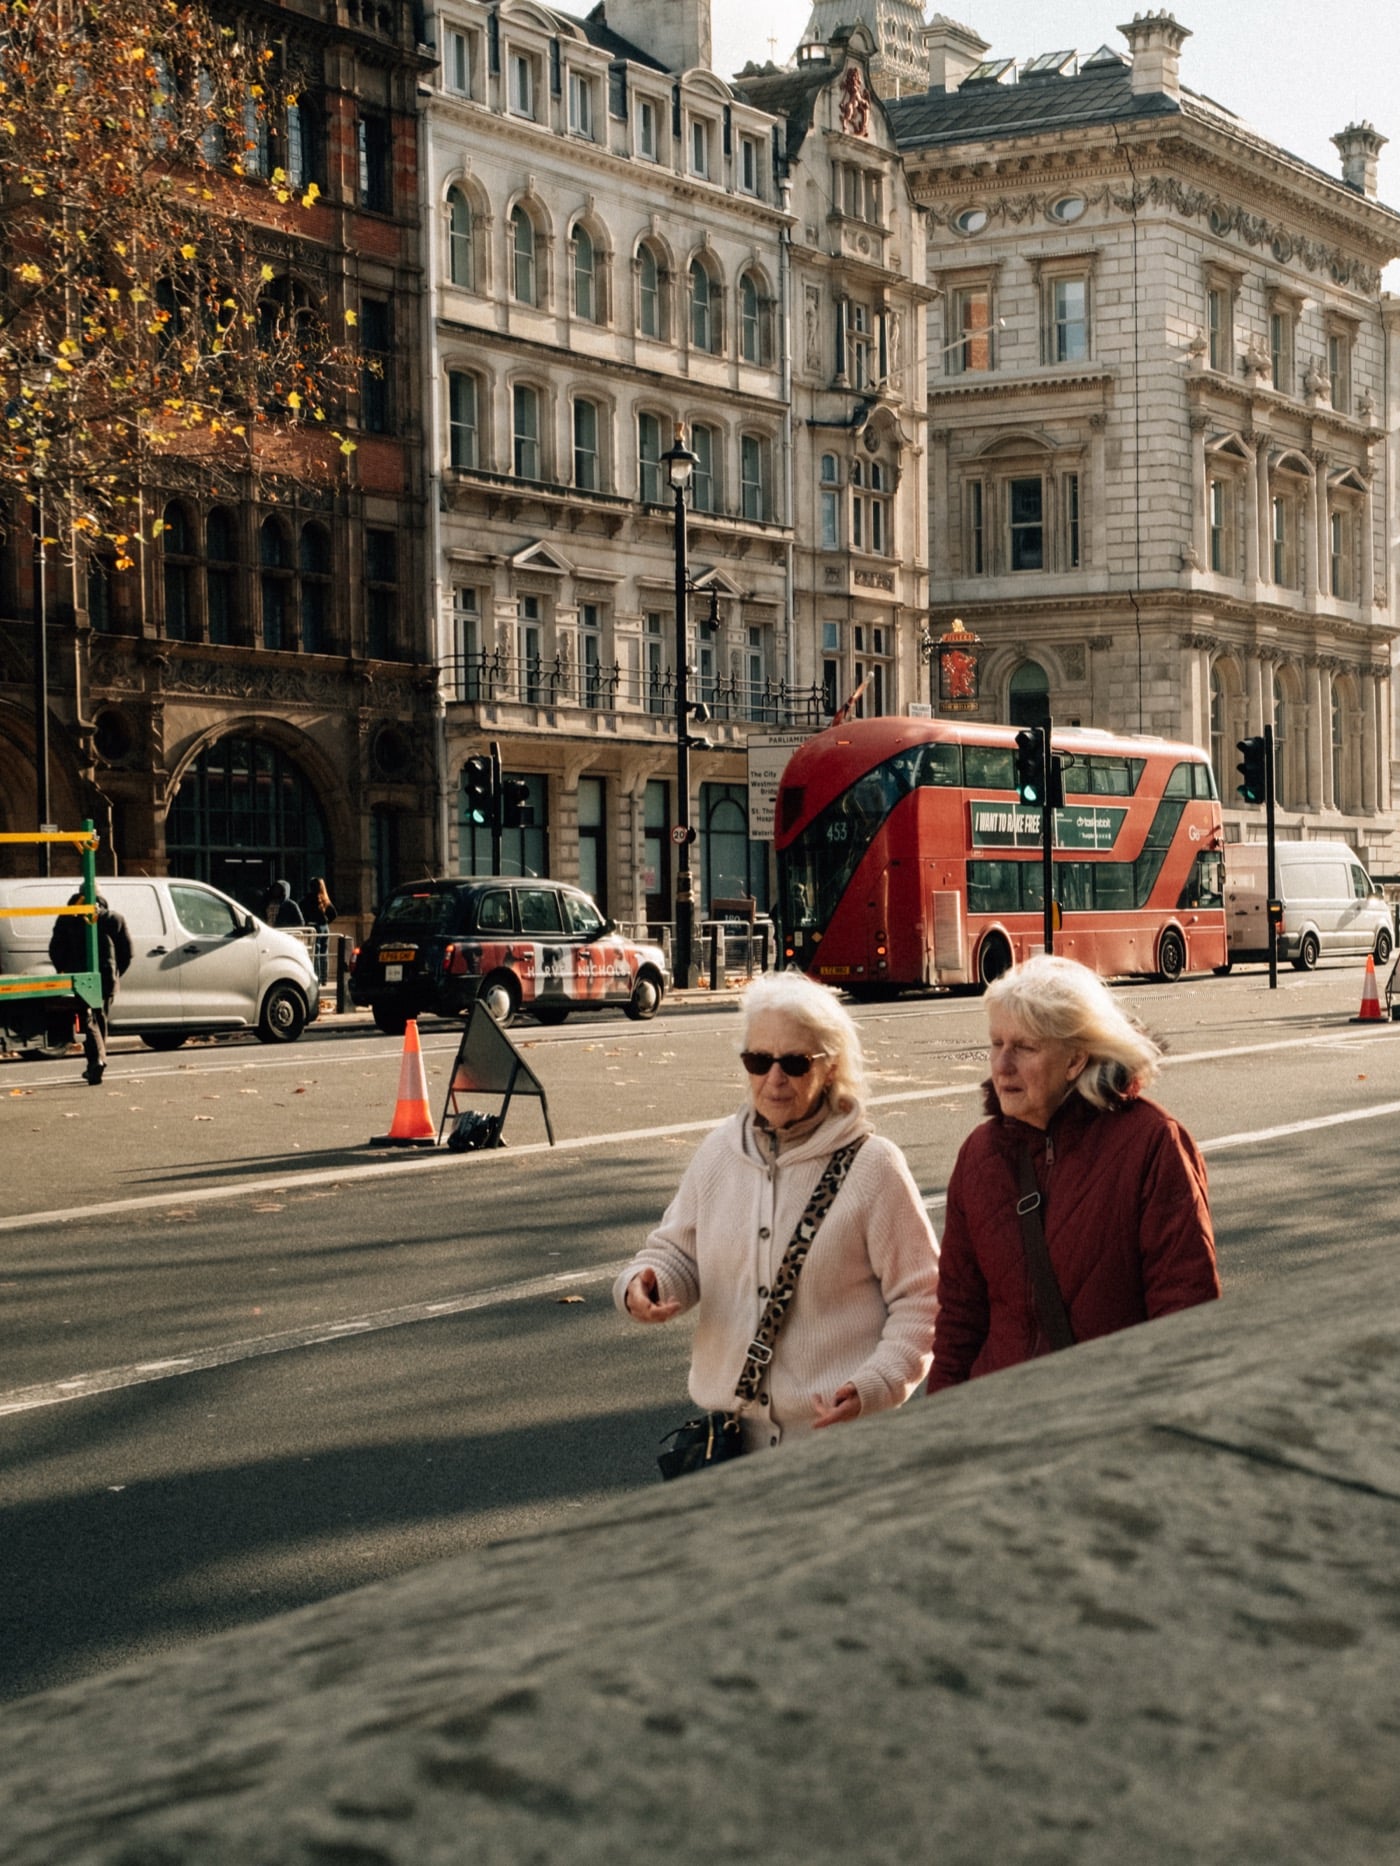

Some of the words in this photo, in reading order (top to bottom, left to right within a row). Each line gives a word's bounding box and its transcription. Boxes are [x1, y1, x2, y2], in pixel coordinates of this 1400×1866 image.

[827, 822, 847, 841] 453
[975, 812, 979, 831] I
[979, 812, 998, 832] WANT
[998, 813, 1007, 832] TO
[1024, 814, 1040, 834] FREE
[673, 831, 684, 839] 20
